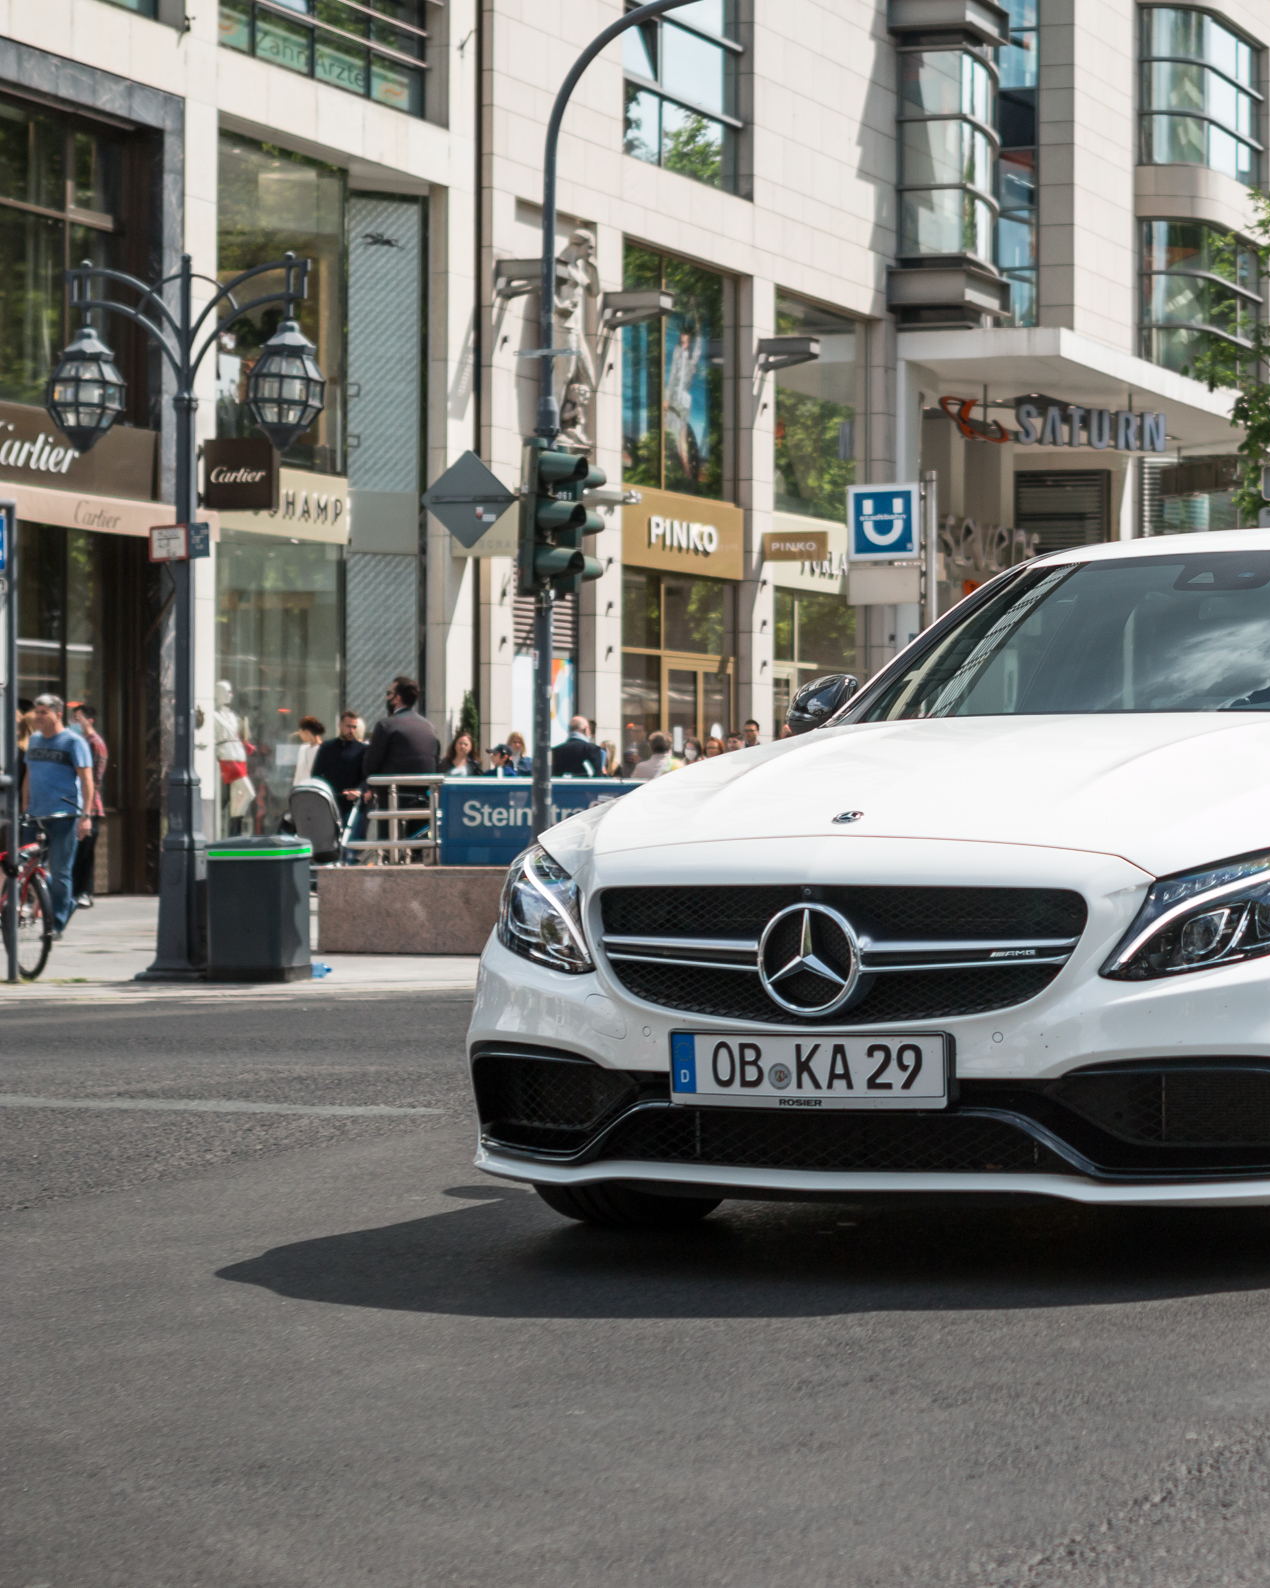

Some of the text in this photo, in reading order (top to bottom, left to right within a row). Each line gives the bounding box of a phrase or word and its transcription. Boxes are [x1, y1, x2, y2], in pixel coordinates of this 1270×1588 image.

[1016, 403, 1167, 452] SATURN
[0, 420, 80, 474] artier
[210, 466, 266, 483] Cartier
[73, 500, 121, 529] Cartier
[859, 513, 906, 522] stadtbahn
[650, 515, 718, 554] PINKO
[770, 541, 818, 552] PINKO
[1004, 949, 1036, 957] AMG
[711, 1041, 923, 1090] OB KA 29
[680, 1069, 690, 1083] D
[778, 1098, 823, 1107] ROSIER
